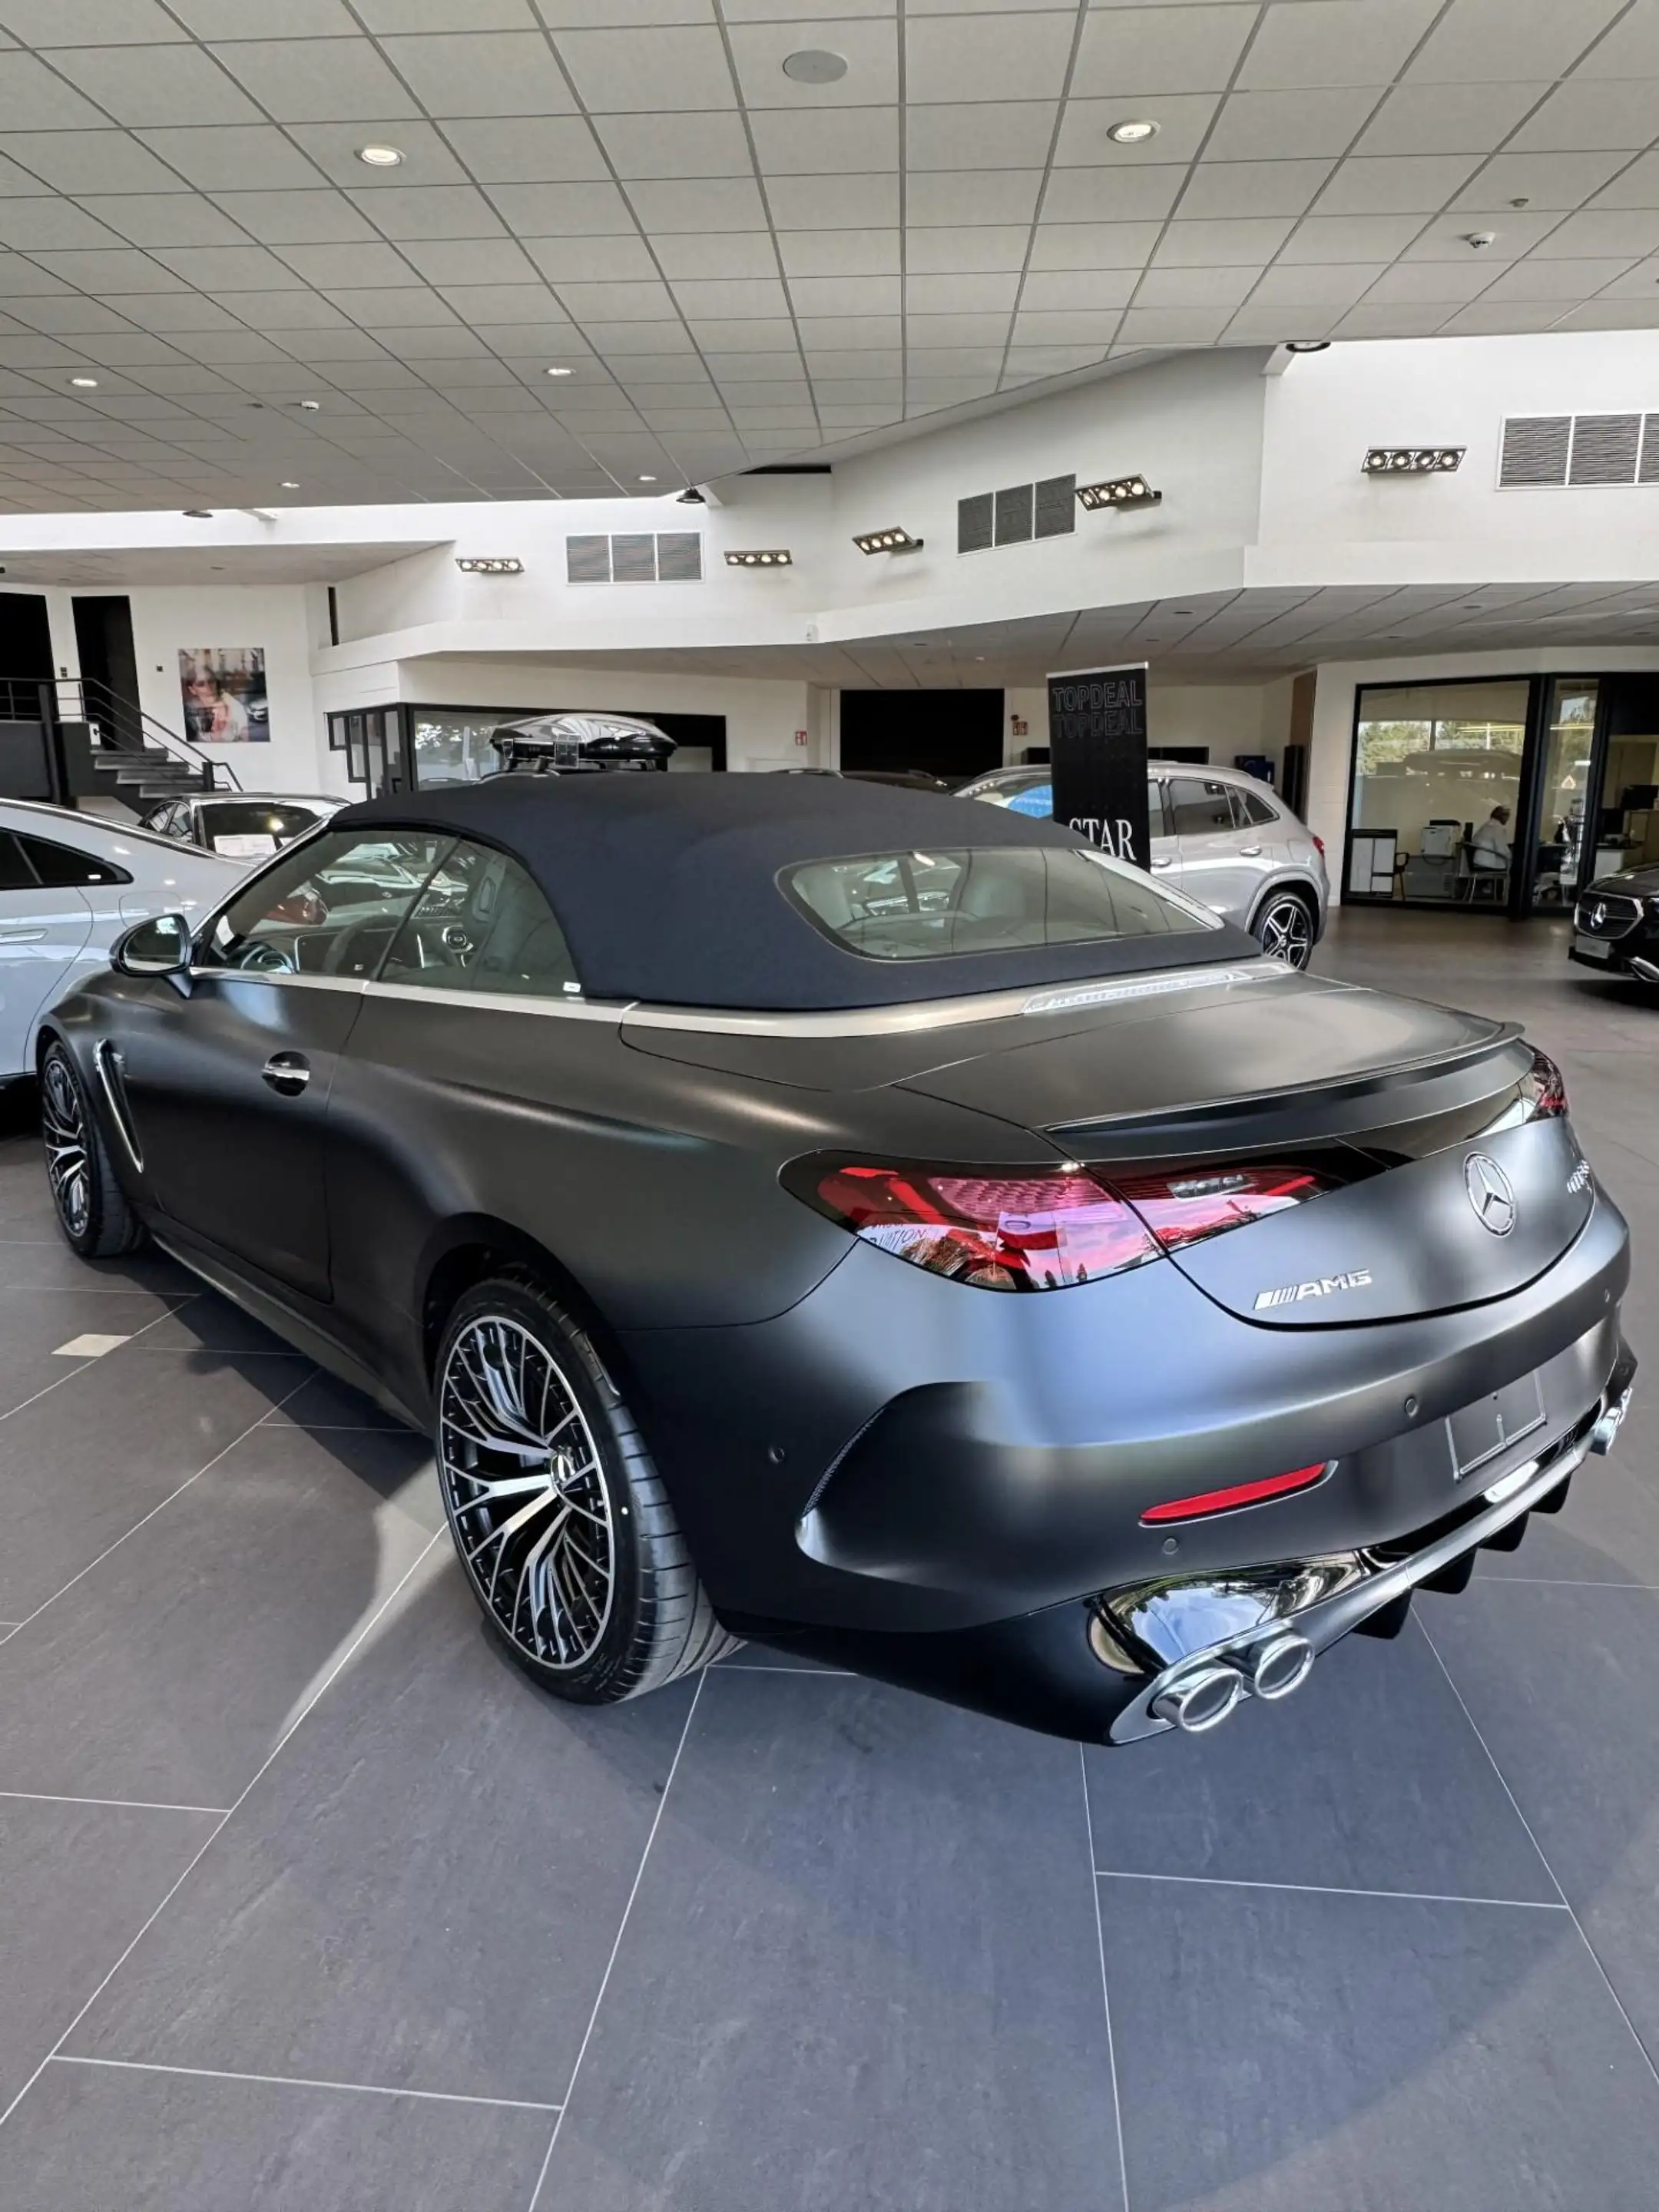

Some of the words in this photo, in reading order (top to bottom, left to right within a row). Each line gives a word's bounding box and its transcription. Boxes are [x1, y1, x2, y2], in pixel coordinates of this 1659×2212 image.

[1051, 680, 1143, 712] TOPDEAL
[1054, 710, 1143, 738] TOPDEAL
[1296, 1268, 1373, 1301] AMG
